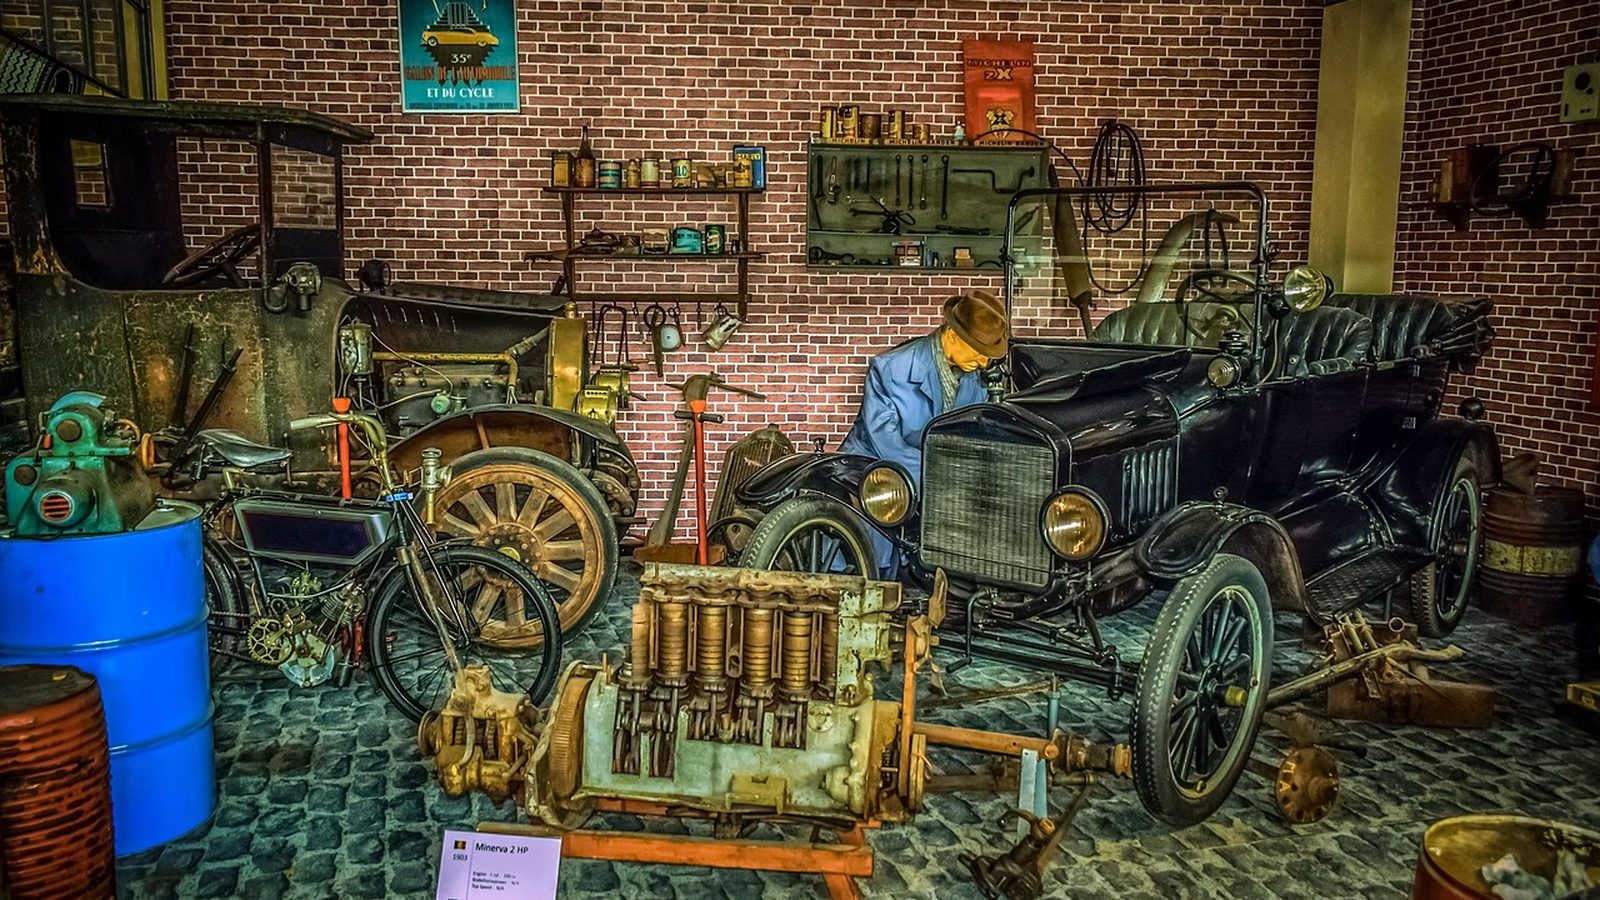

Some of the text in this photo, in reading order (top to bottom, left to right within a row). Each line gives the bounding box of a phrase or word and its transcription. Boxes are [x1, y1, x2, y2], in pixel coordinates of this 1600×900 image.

[967, 59, 1031, 67] MICHELIN
[427, 88, 495, 98] ET DU CYCLE
[475, 842, 529, 854] Minerva 2 HP
[452, 853, 468, 861] 1903
